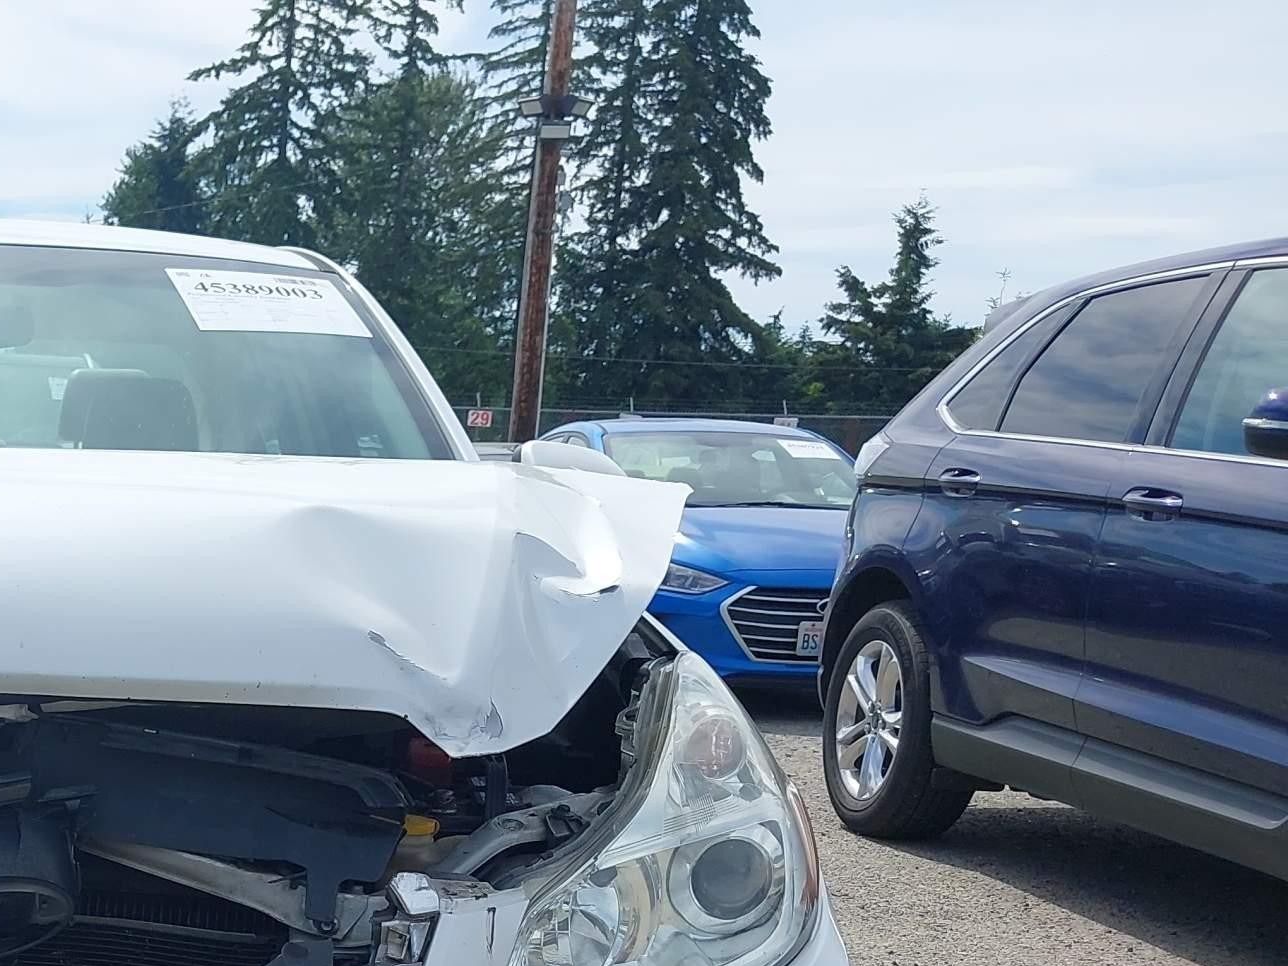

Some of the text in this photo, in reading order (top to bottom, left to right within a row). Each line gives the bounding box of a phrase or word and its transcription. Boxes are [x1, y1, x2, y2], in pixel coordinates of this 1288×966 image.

[194, 281, 323, 300] 45389003
[470, 411, 490, 426] 29
[801, 633, 818, 650] BS
